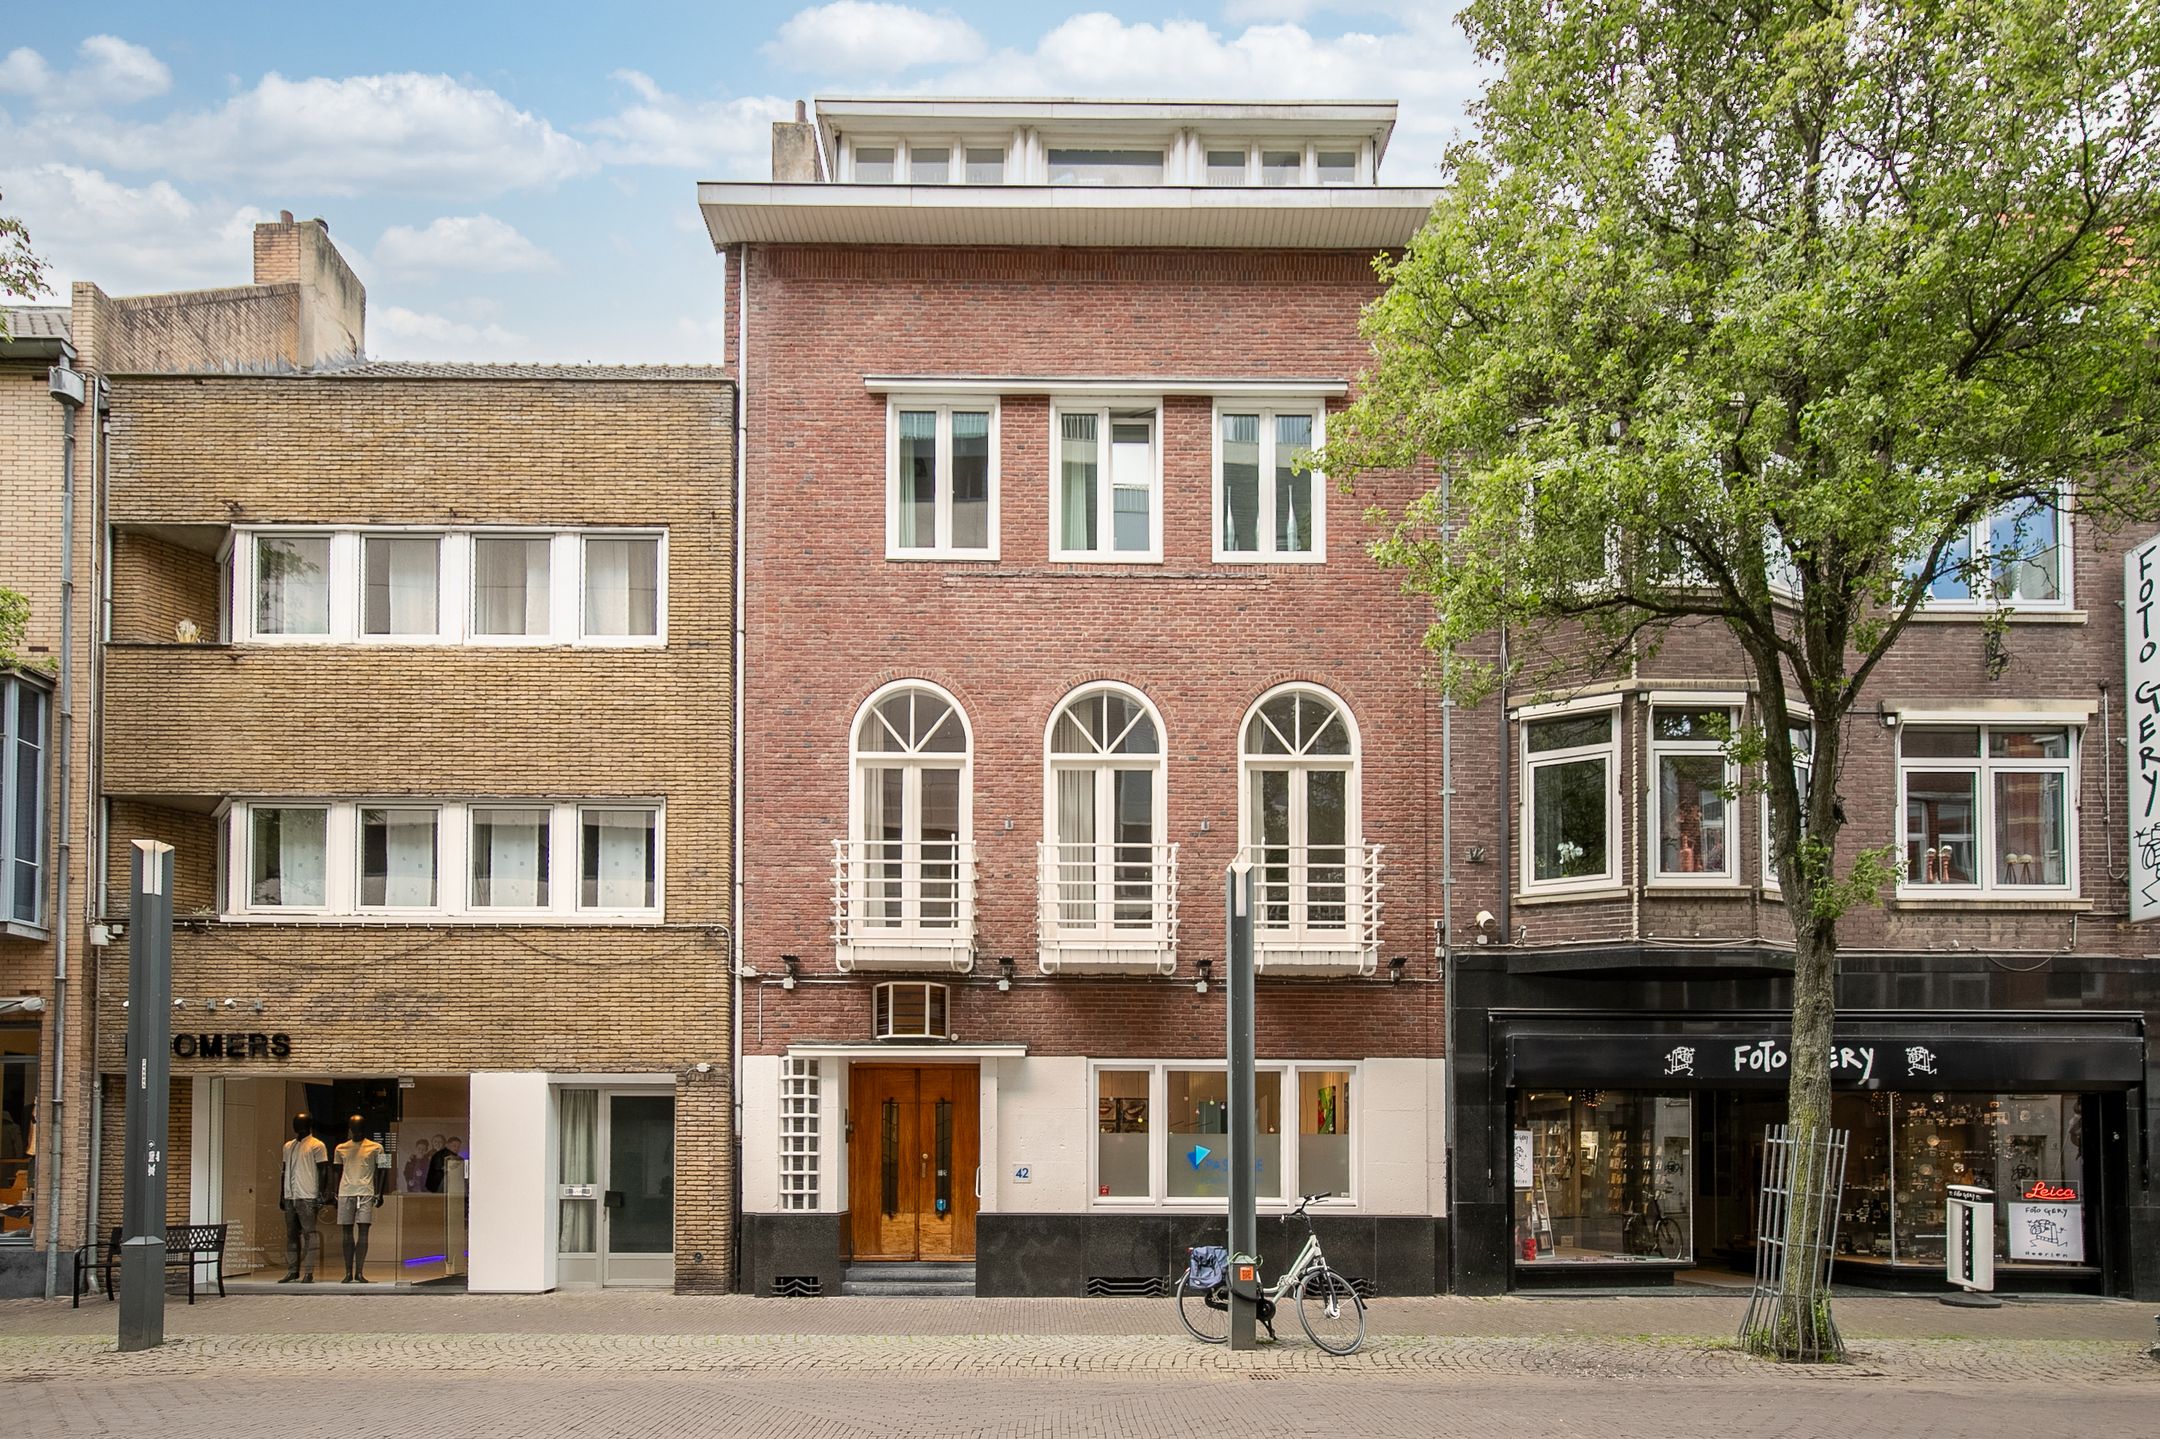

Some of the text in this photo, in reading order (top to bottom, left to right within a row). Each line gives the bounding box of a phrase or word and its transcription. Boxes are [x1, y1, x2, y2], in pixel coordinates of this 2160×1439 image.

[2135, 545, 2160, 818] FOTO GERY
[1830, 1046, 1875, 1085] ERY
[1015, 1168, 1029, 1178] 42
[2025, 1181, 2077, 1200] Leica
[2043, 1207, 2068, 1218] GERY
